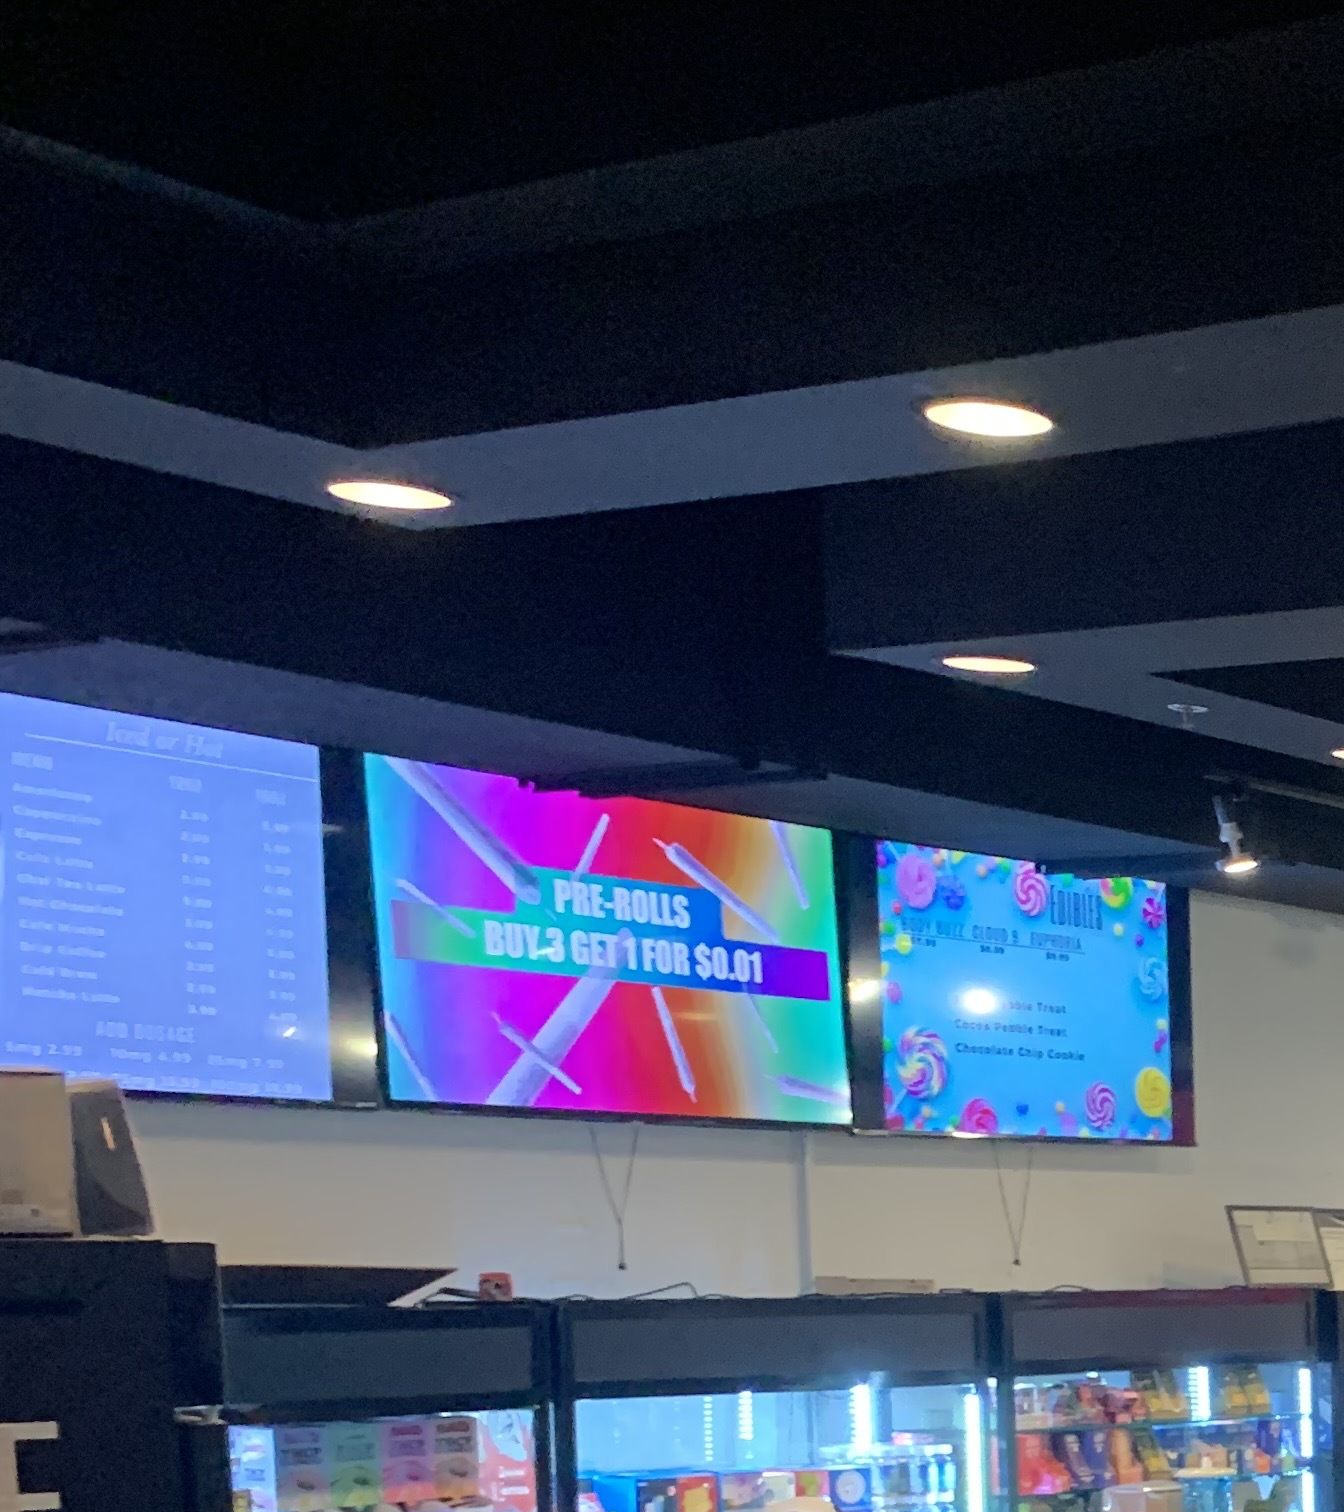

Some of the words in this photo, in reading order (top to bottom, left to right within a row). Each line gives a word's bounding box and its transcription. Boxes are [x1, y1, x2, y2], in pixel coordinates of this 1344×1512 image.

[553, 878, 691, 929] PRE-ROLLS
[483, 919, 541, 961] BUY
[545, 926, 565, 963] 3
[570, 930, 619, 968] GET
[625, 936, 639, 971] 1
[642, 938, 690, 976] FOR
[694, 941, 764, 984] $0.01
[1047, 1048, 1085, 1061] Cookie
